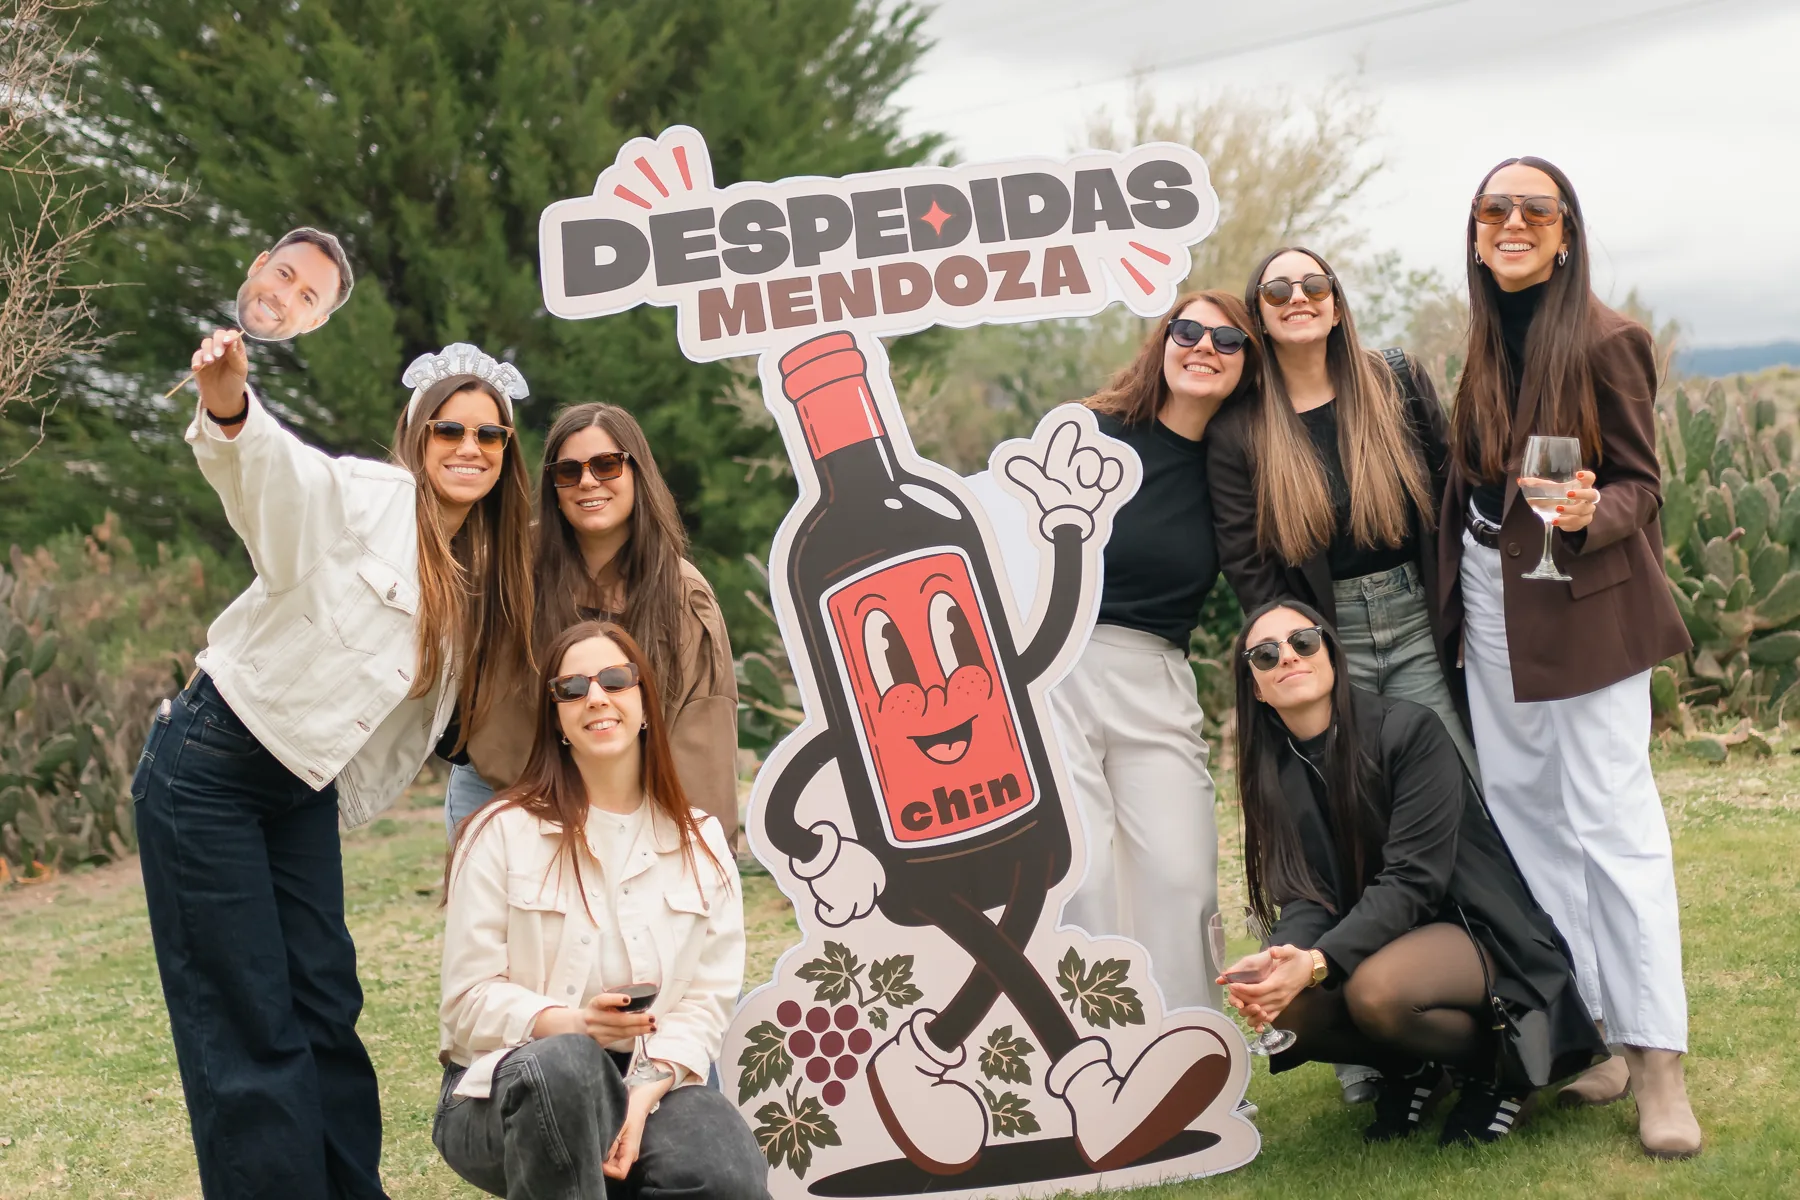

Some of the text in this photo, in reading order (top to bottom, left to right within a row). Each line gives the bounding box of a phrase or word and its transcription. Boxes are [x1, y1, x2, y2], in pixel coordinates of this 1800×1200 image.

[561, 160, 1200, 298] DESPEDIDAS
[699, 245, 1092, 341] MENDOZA
[408, 352, 517, 394] BRIDE
[900, 773, 1022, 832] chin
